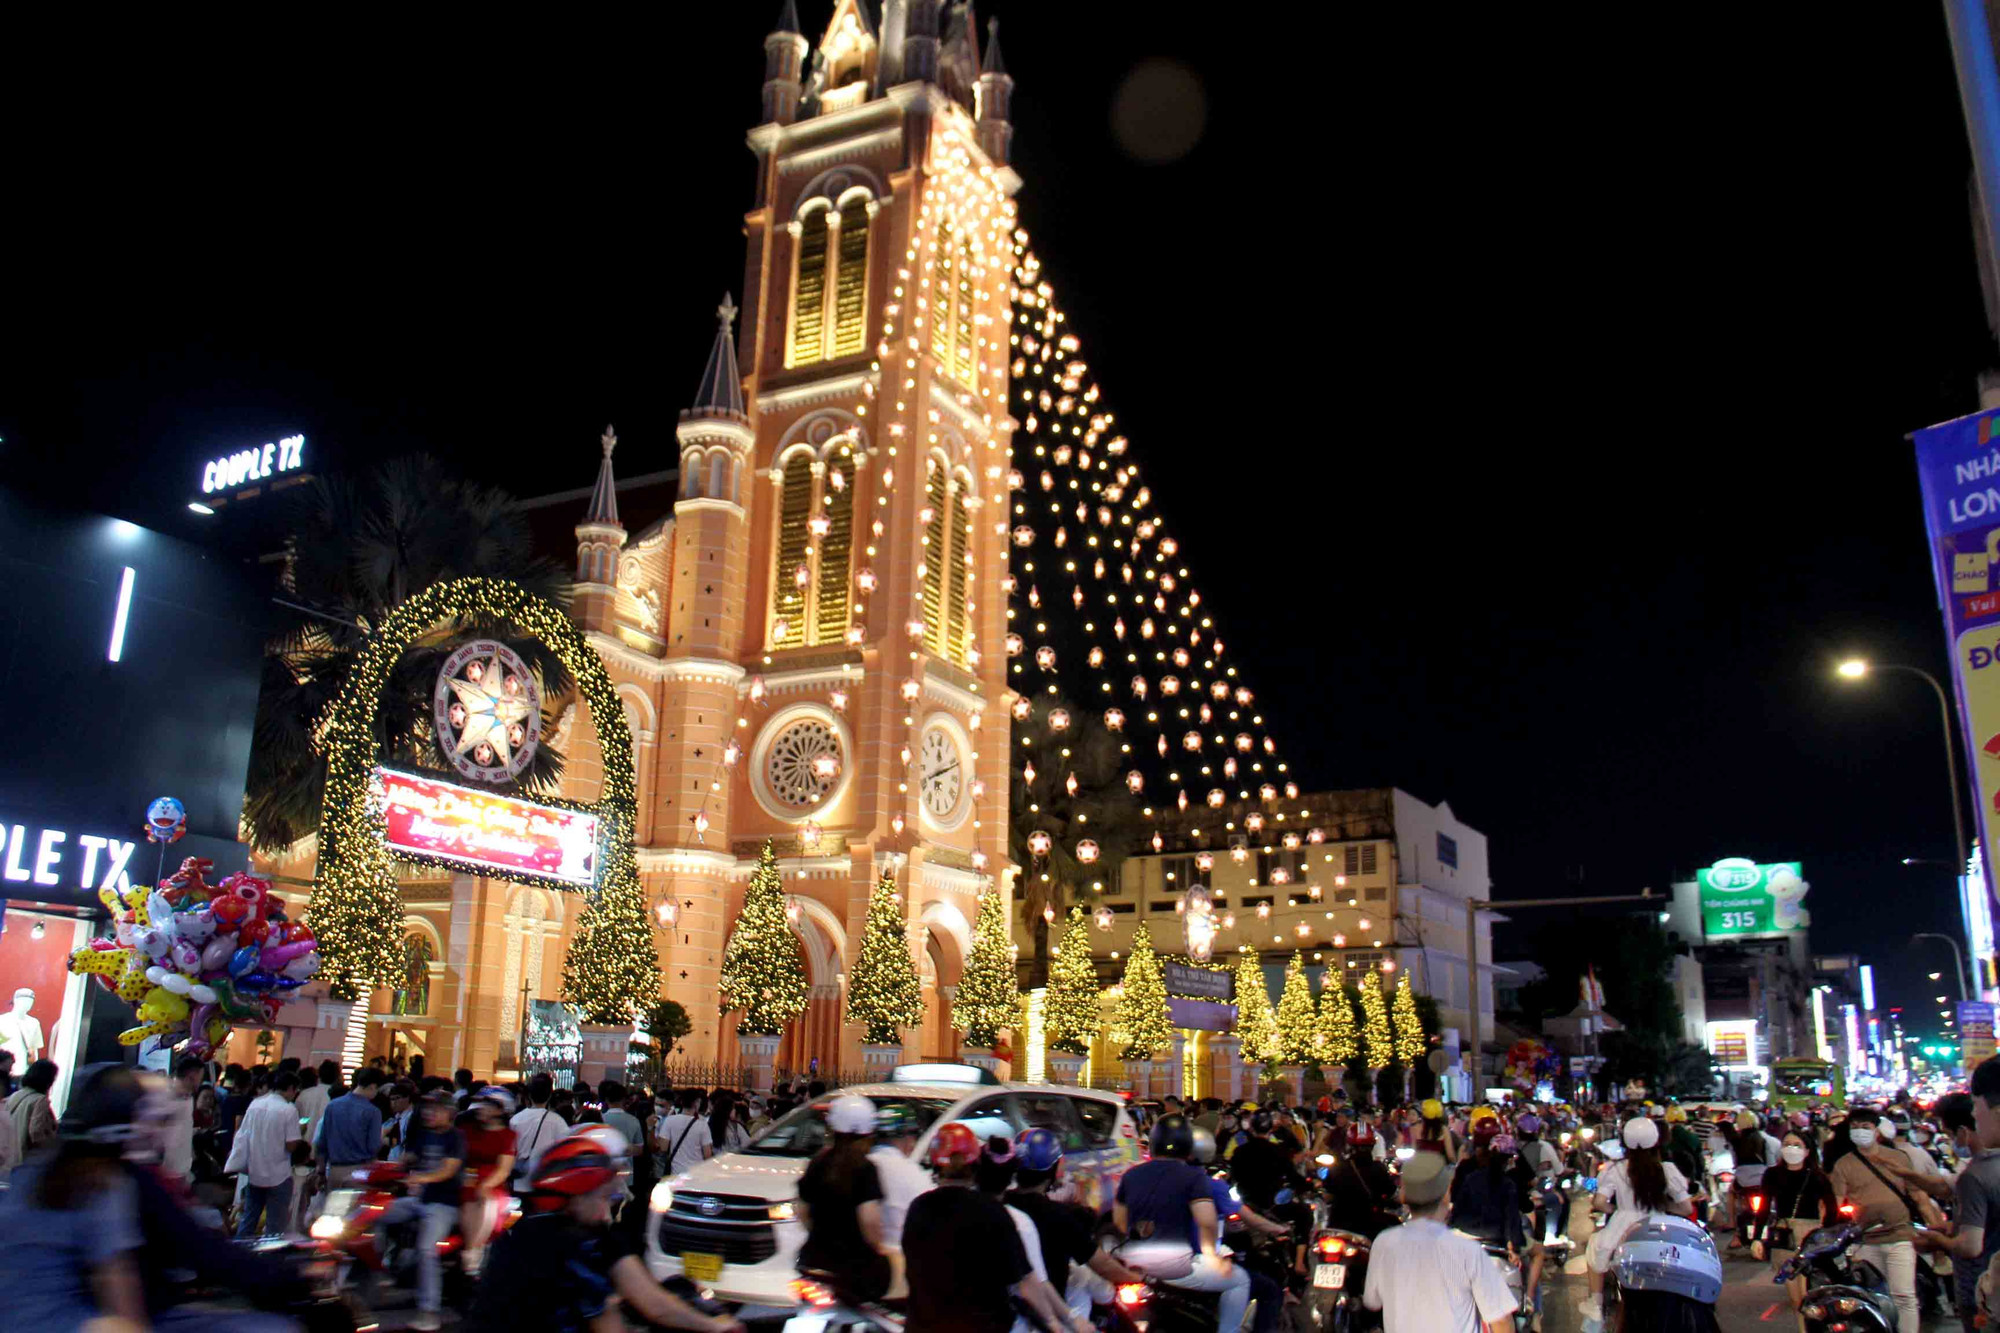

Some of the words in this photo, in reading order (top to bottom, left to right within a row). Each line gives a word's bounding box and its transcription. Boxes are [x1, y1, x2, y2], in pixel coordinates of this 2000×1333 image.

[203, 443, 276, 493] COUPLE
[279, 434, 305, 471] TX
[0, 823, 66, 885] LE
[80, 834, 135, 895] TX
[1722, 911, 1755, 928] 315
